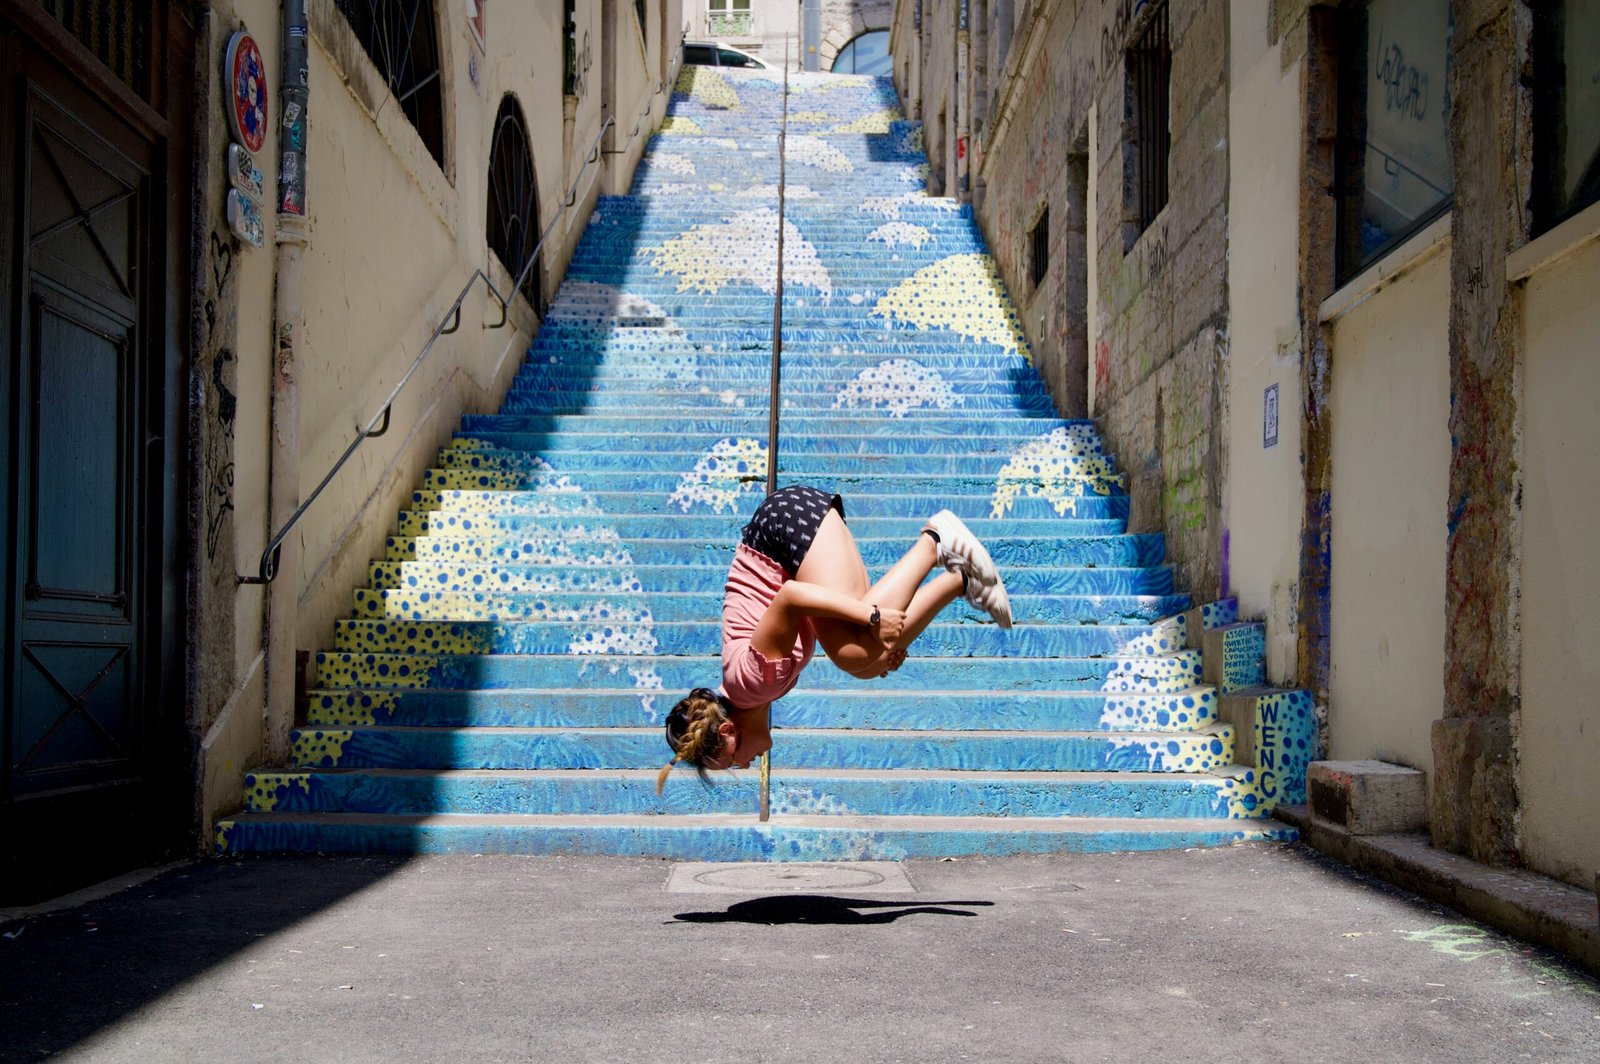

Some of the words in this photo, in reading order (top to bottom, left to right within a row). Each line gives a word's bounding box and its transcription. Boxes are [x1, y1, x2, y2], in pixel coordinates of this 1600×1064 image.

[1224, 653, 1245, 661] LYON
[1224, 660, 1251, 669] PENTES
[1260, 700, 1279, 798] WENC
